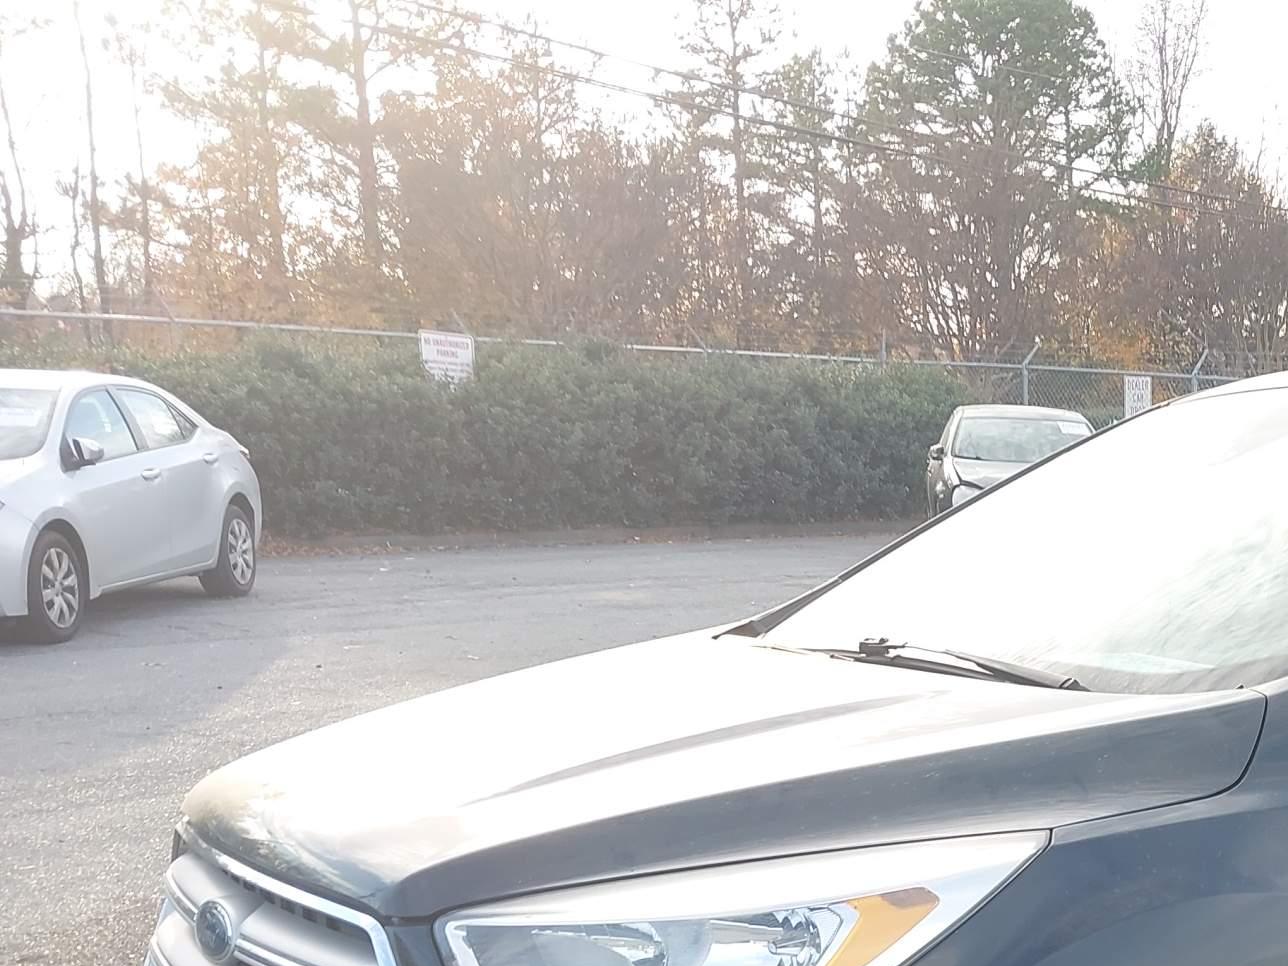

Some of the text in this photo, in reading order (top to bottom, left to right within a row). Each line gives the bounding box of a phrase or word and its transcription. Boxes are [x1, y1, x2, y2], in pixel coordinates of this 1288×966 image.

[436, 348, 459, 360] PARKING
[1127, 378, 1150, 391] DEALER
[1132, 392, 1145, 404] CAR
